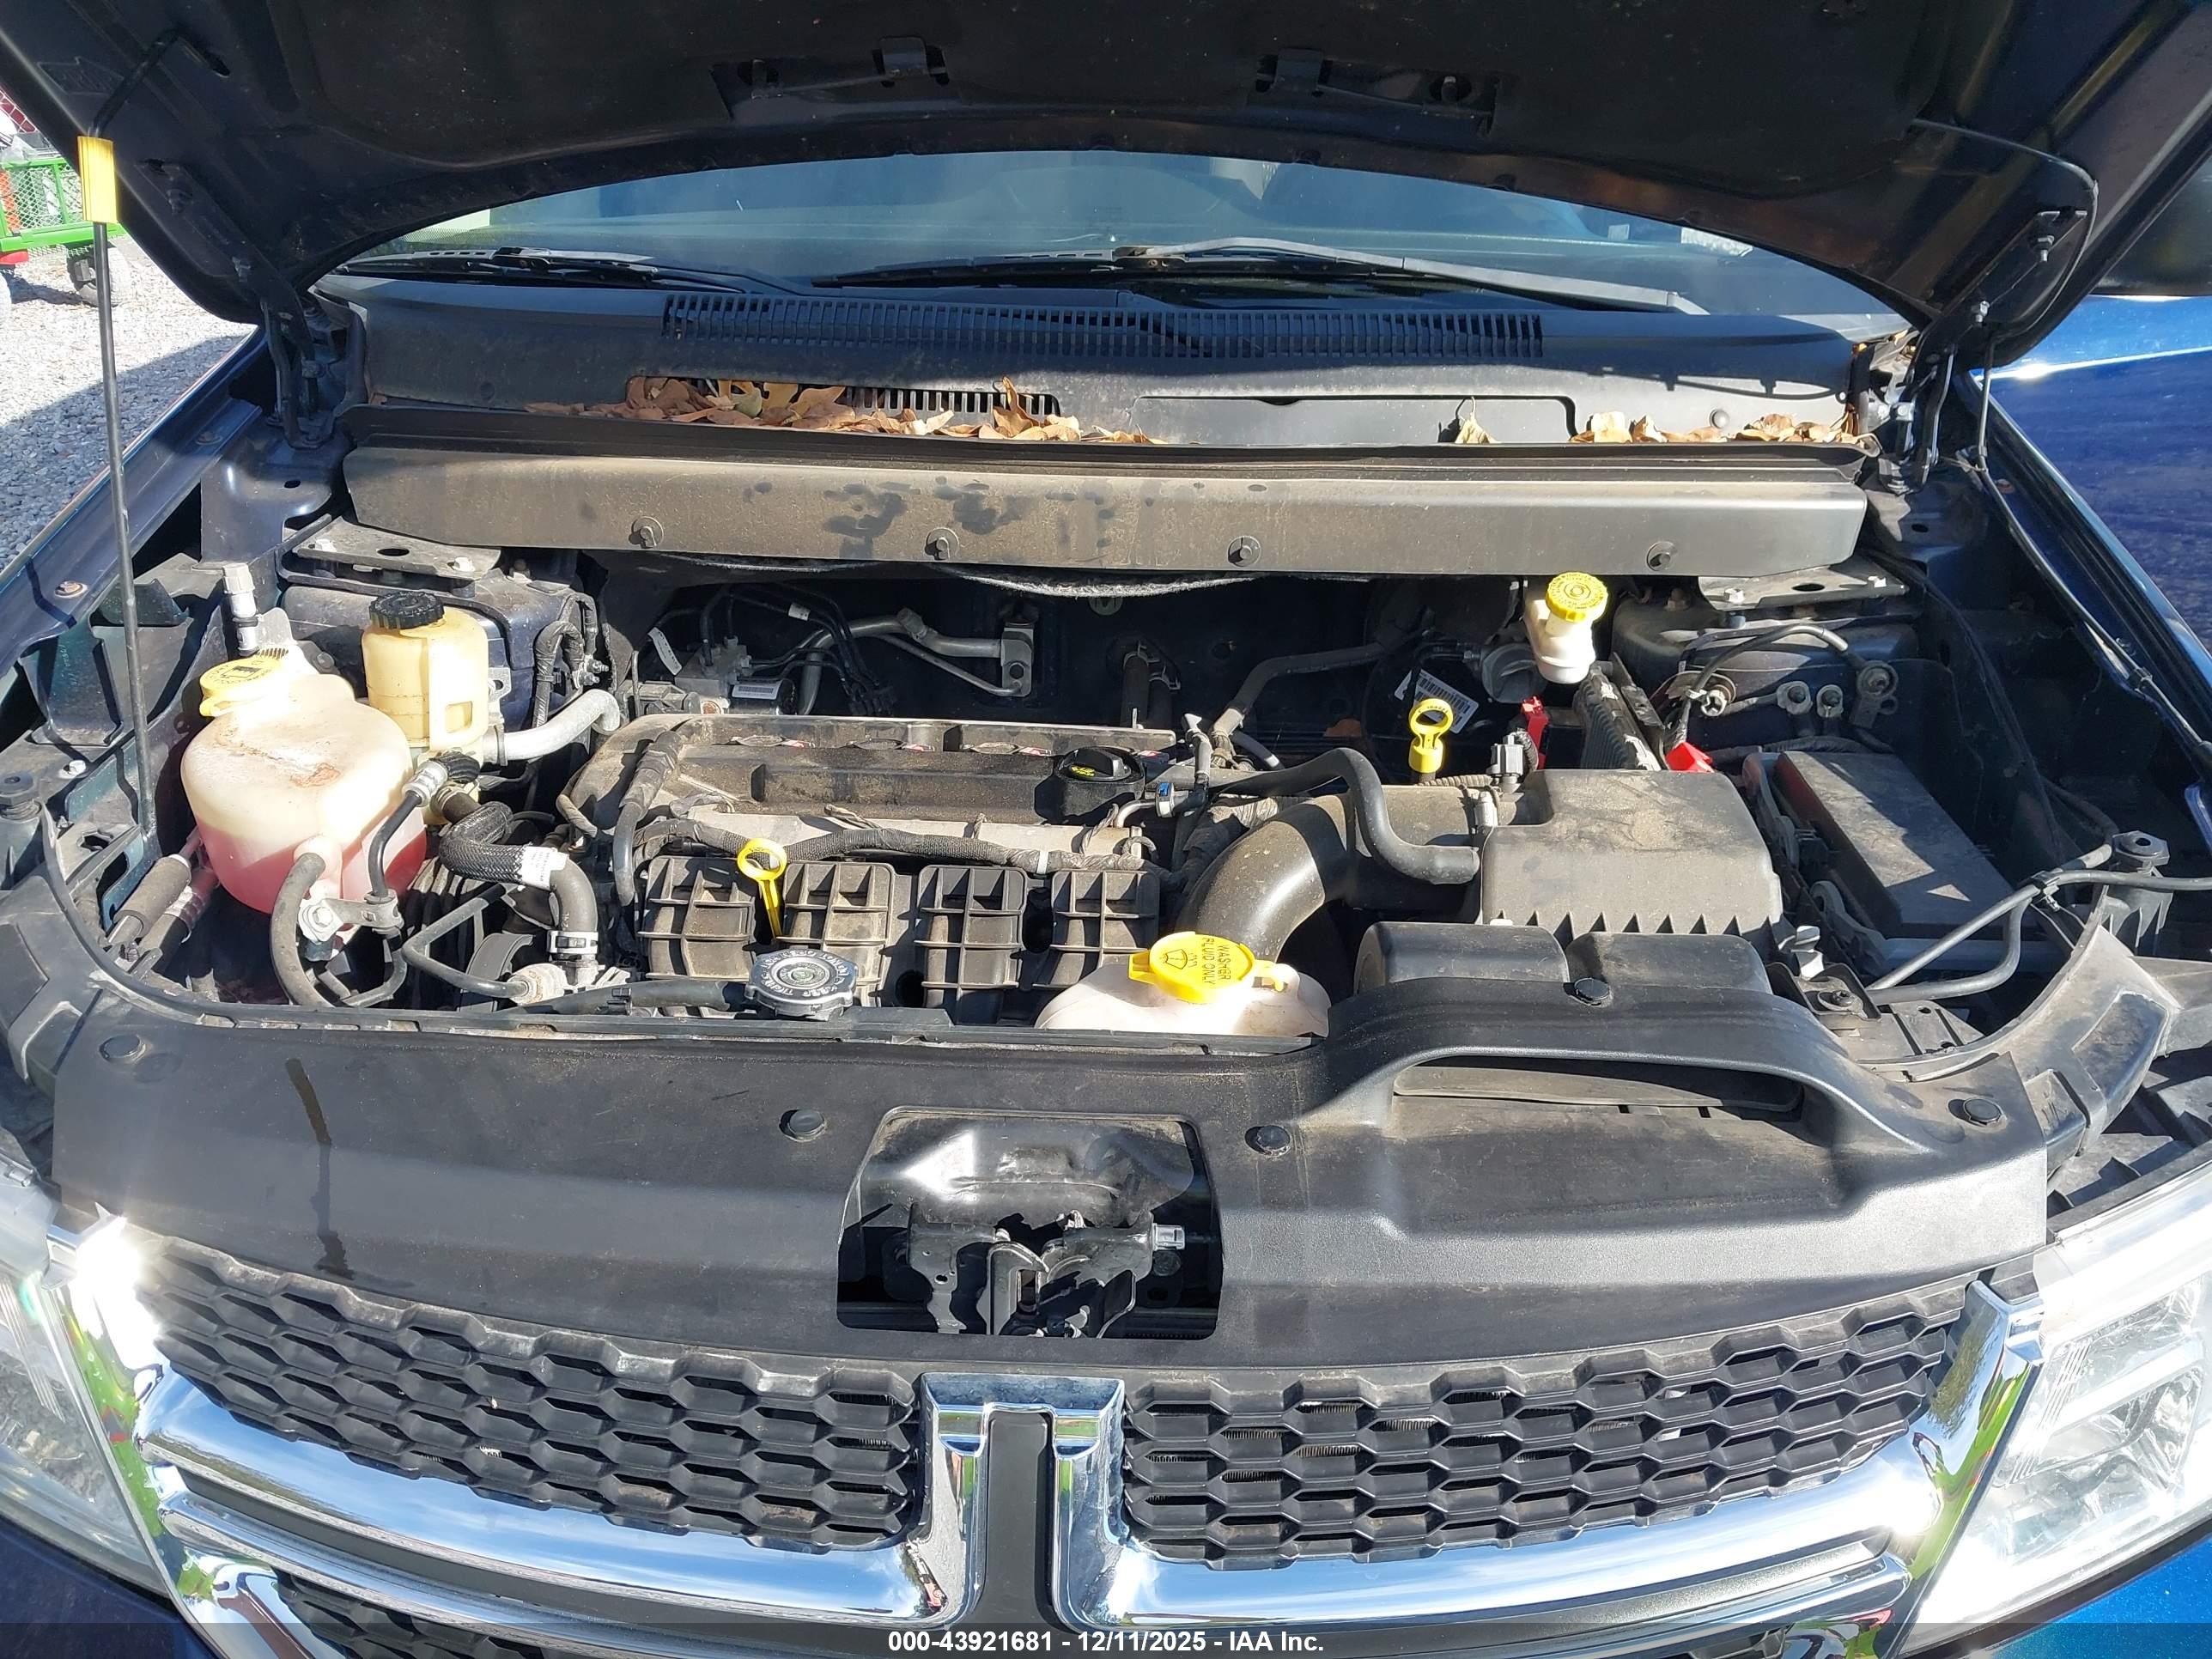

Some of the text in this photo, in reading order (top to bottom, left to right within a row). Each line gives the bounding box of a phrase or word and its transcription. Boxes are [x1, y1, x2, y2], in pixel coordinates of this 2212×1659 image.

[1201, 937, 1216, 985] FLUID ONLY
[1216, 945, 1231, 981] WASHER
